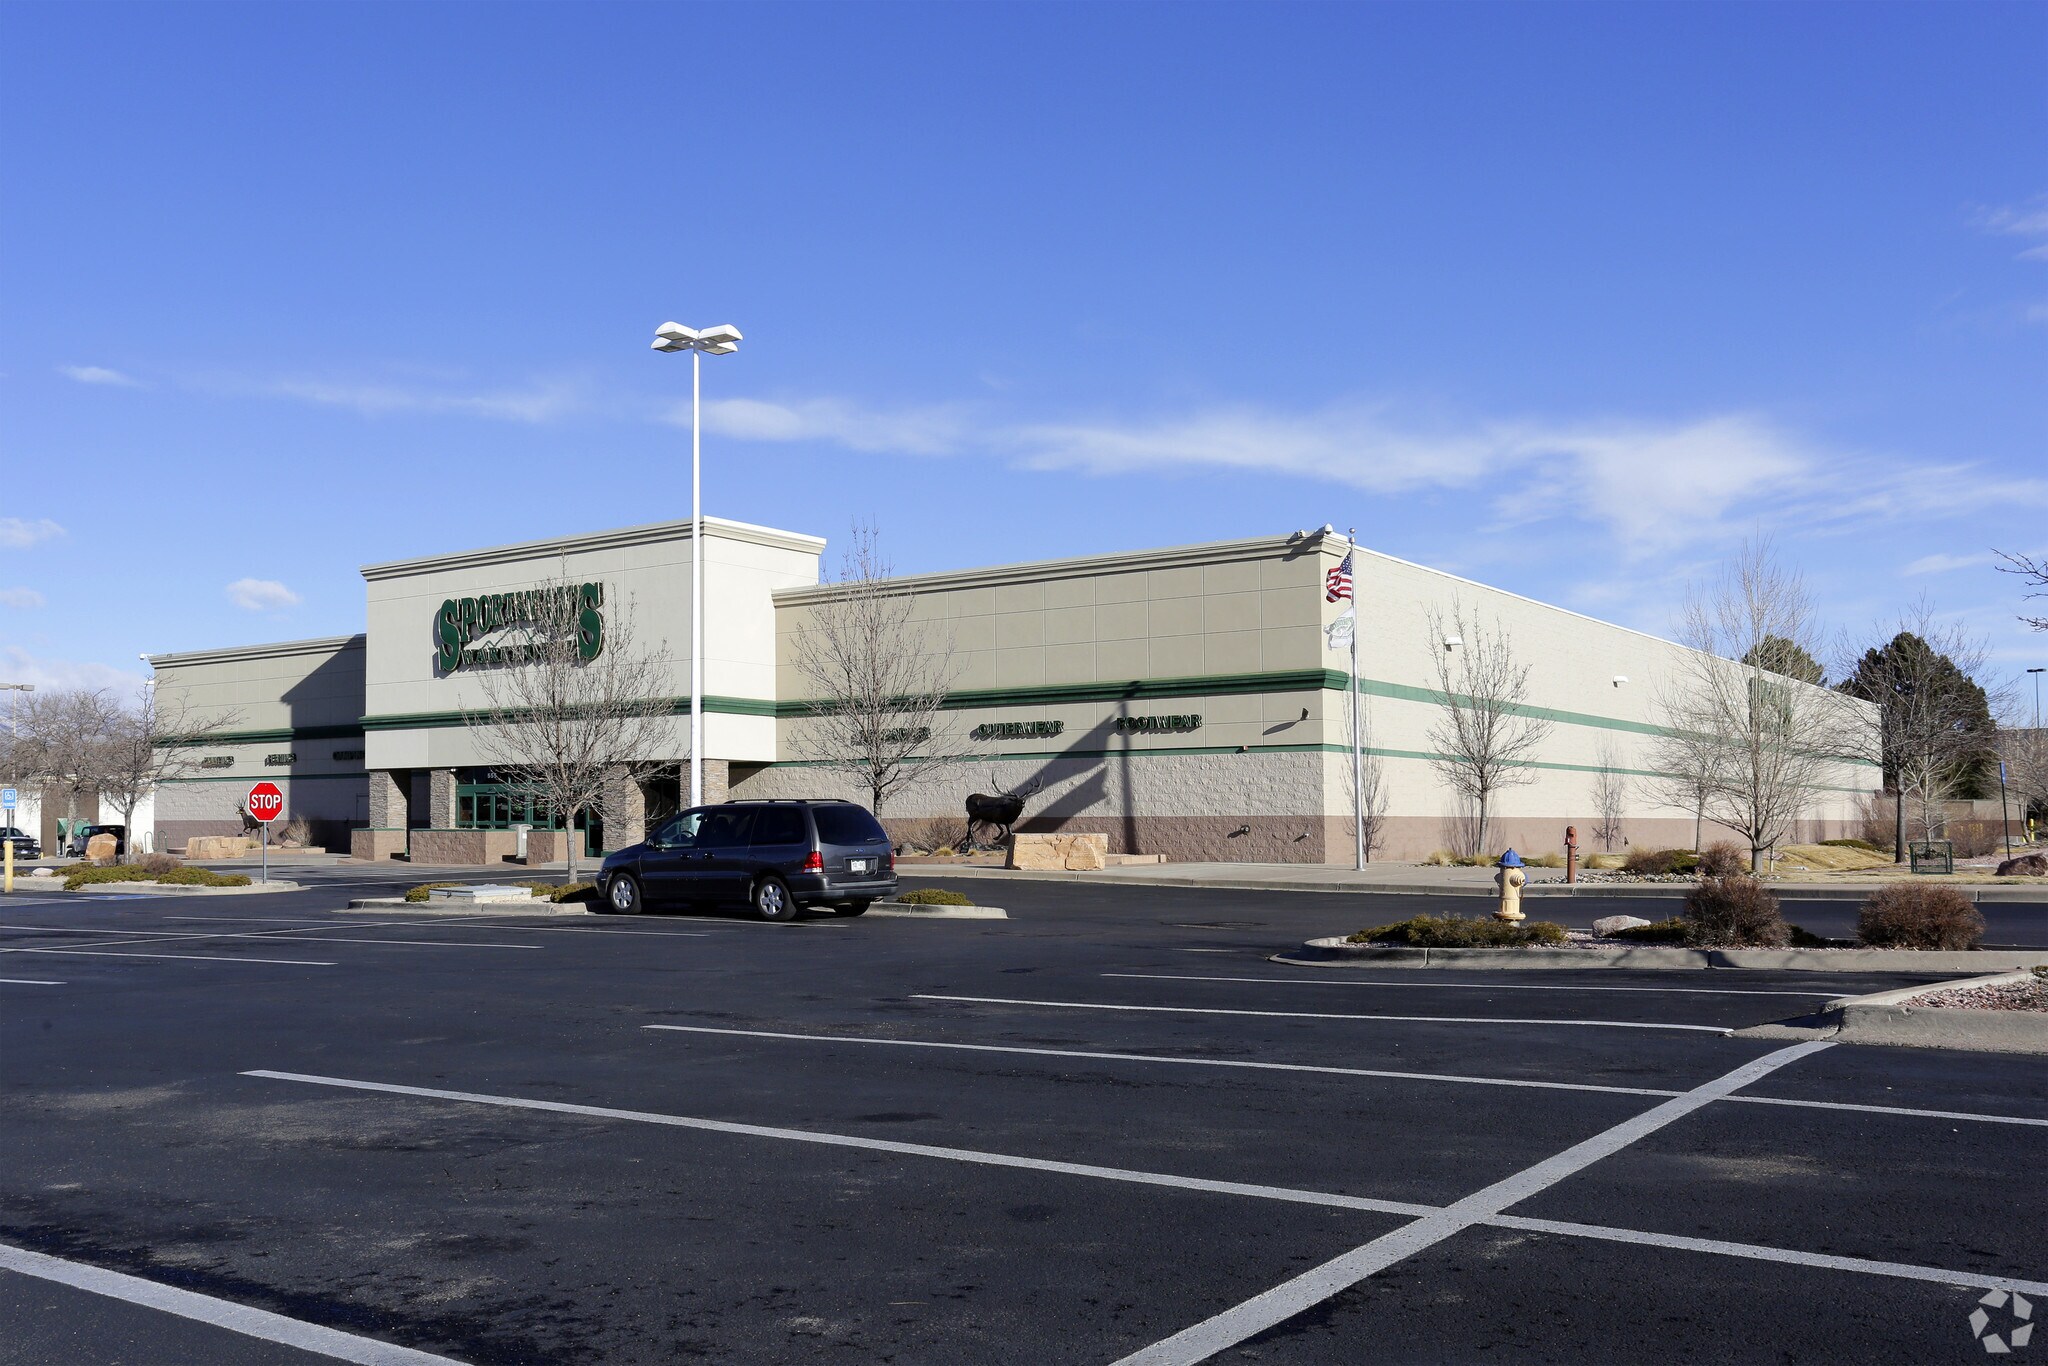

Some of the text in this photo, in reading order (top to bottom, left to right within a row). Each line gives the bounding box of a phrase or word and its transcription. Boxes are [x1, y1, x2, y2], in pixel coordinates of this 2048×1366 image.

[461, 640, 578, 665] WAREO
[978, 720, 1064, 736] OUTERWEAR
[1117, 714, 1202, 730] FOOTWEAR
[251, 794, 281, 809] STOP
